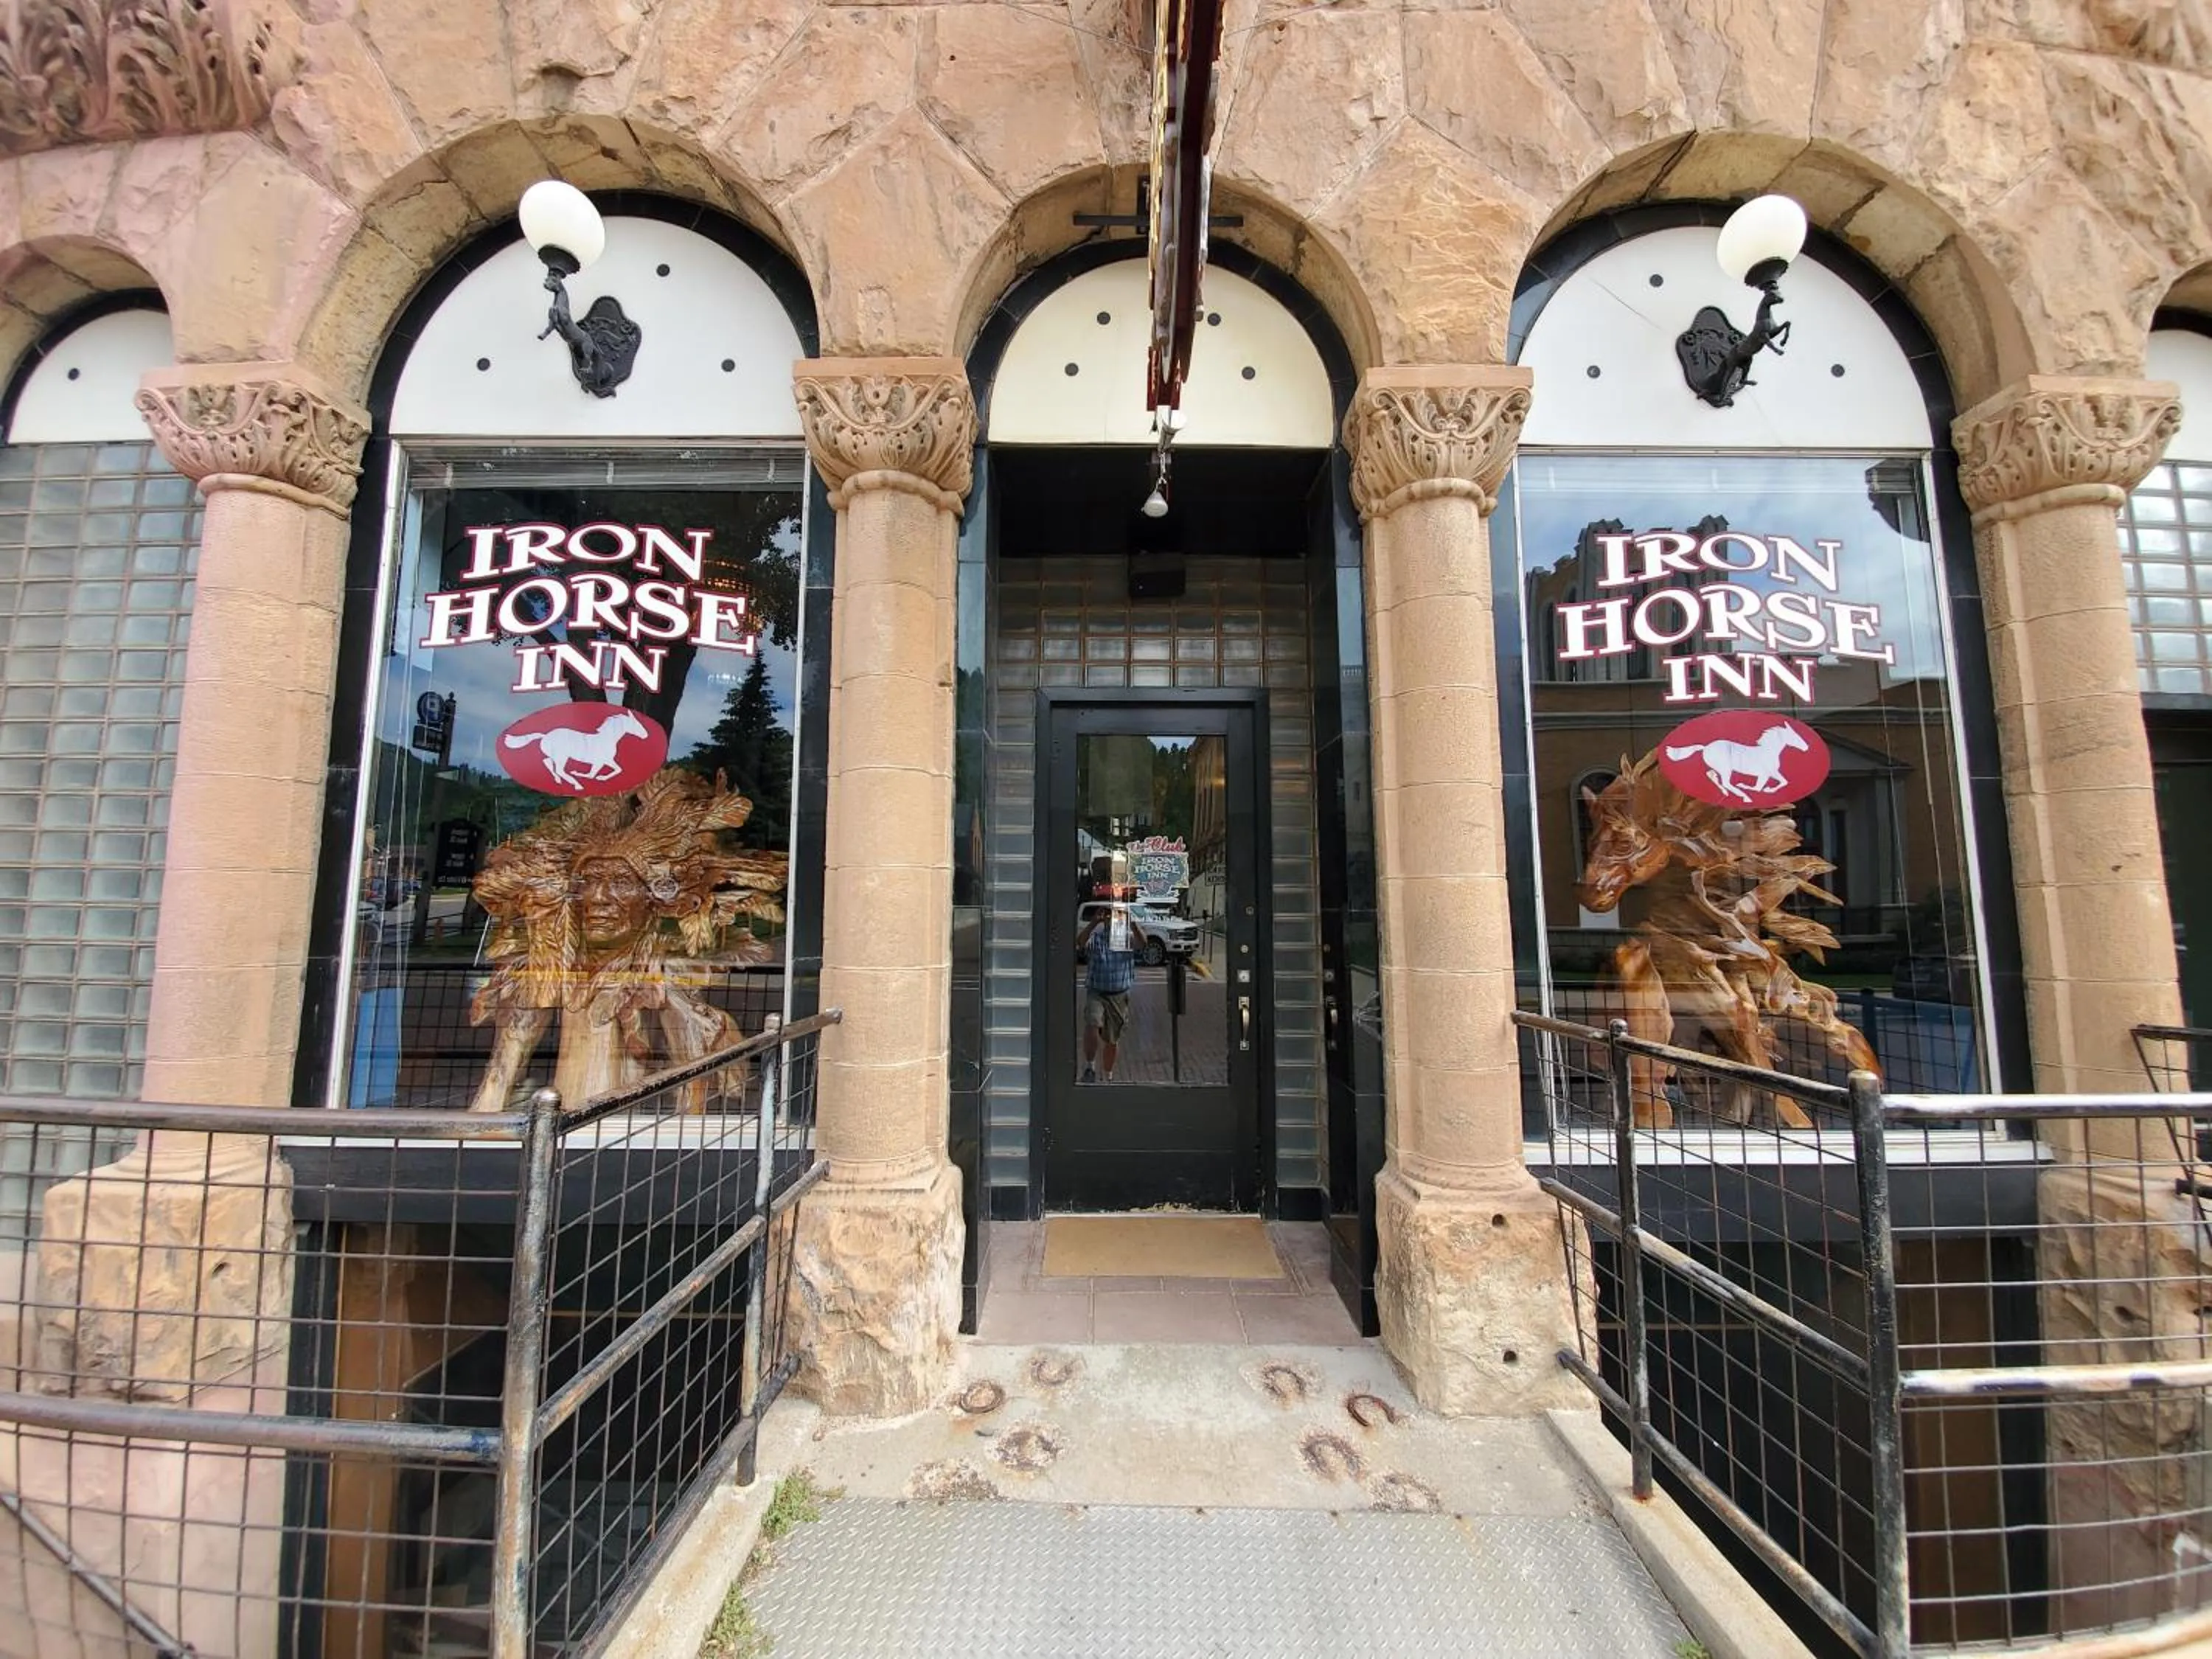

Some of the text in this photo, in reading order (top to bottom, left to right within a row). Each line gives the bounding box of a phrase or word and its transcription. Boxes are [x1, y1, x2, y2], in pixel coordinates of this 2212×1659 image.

[462, 522, 713, 582] IRON
[1597, 531, 1843, 592] IRON
[420, 573, 755, 655] HORSE
[1557, 582, 1896, 665] HORSE
[511, 641, 667, 692] INN
[1663, 652, 1819, 704] INN
[1135, 864, 1180, 874] HORSE
[1142, 857, 1175, 865] IRON
